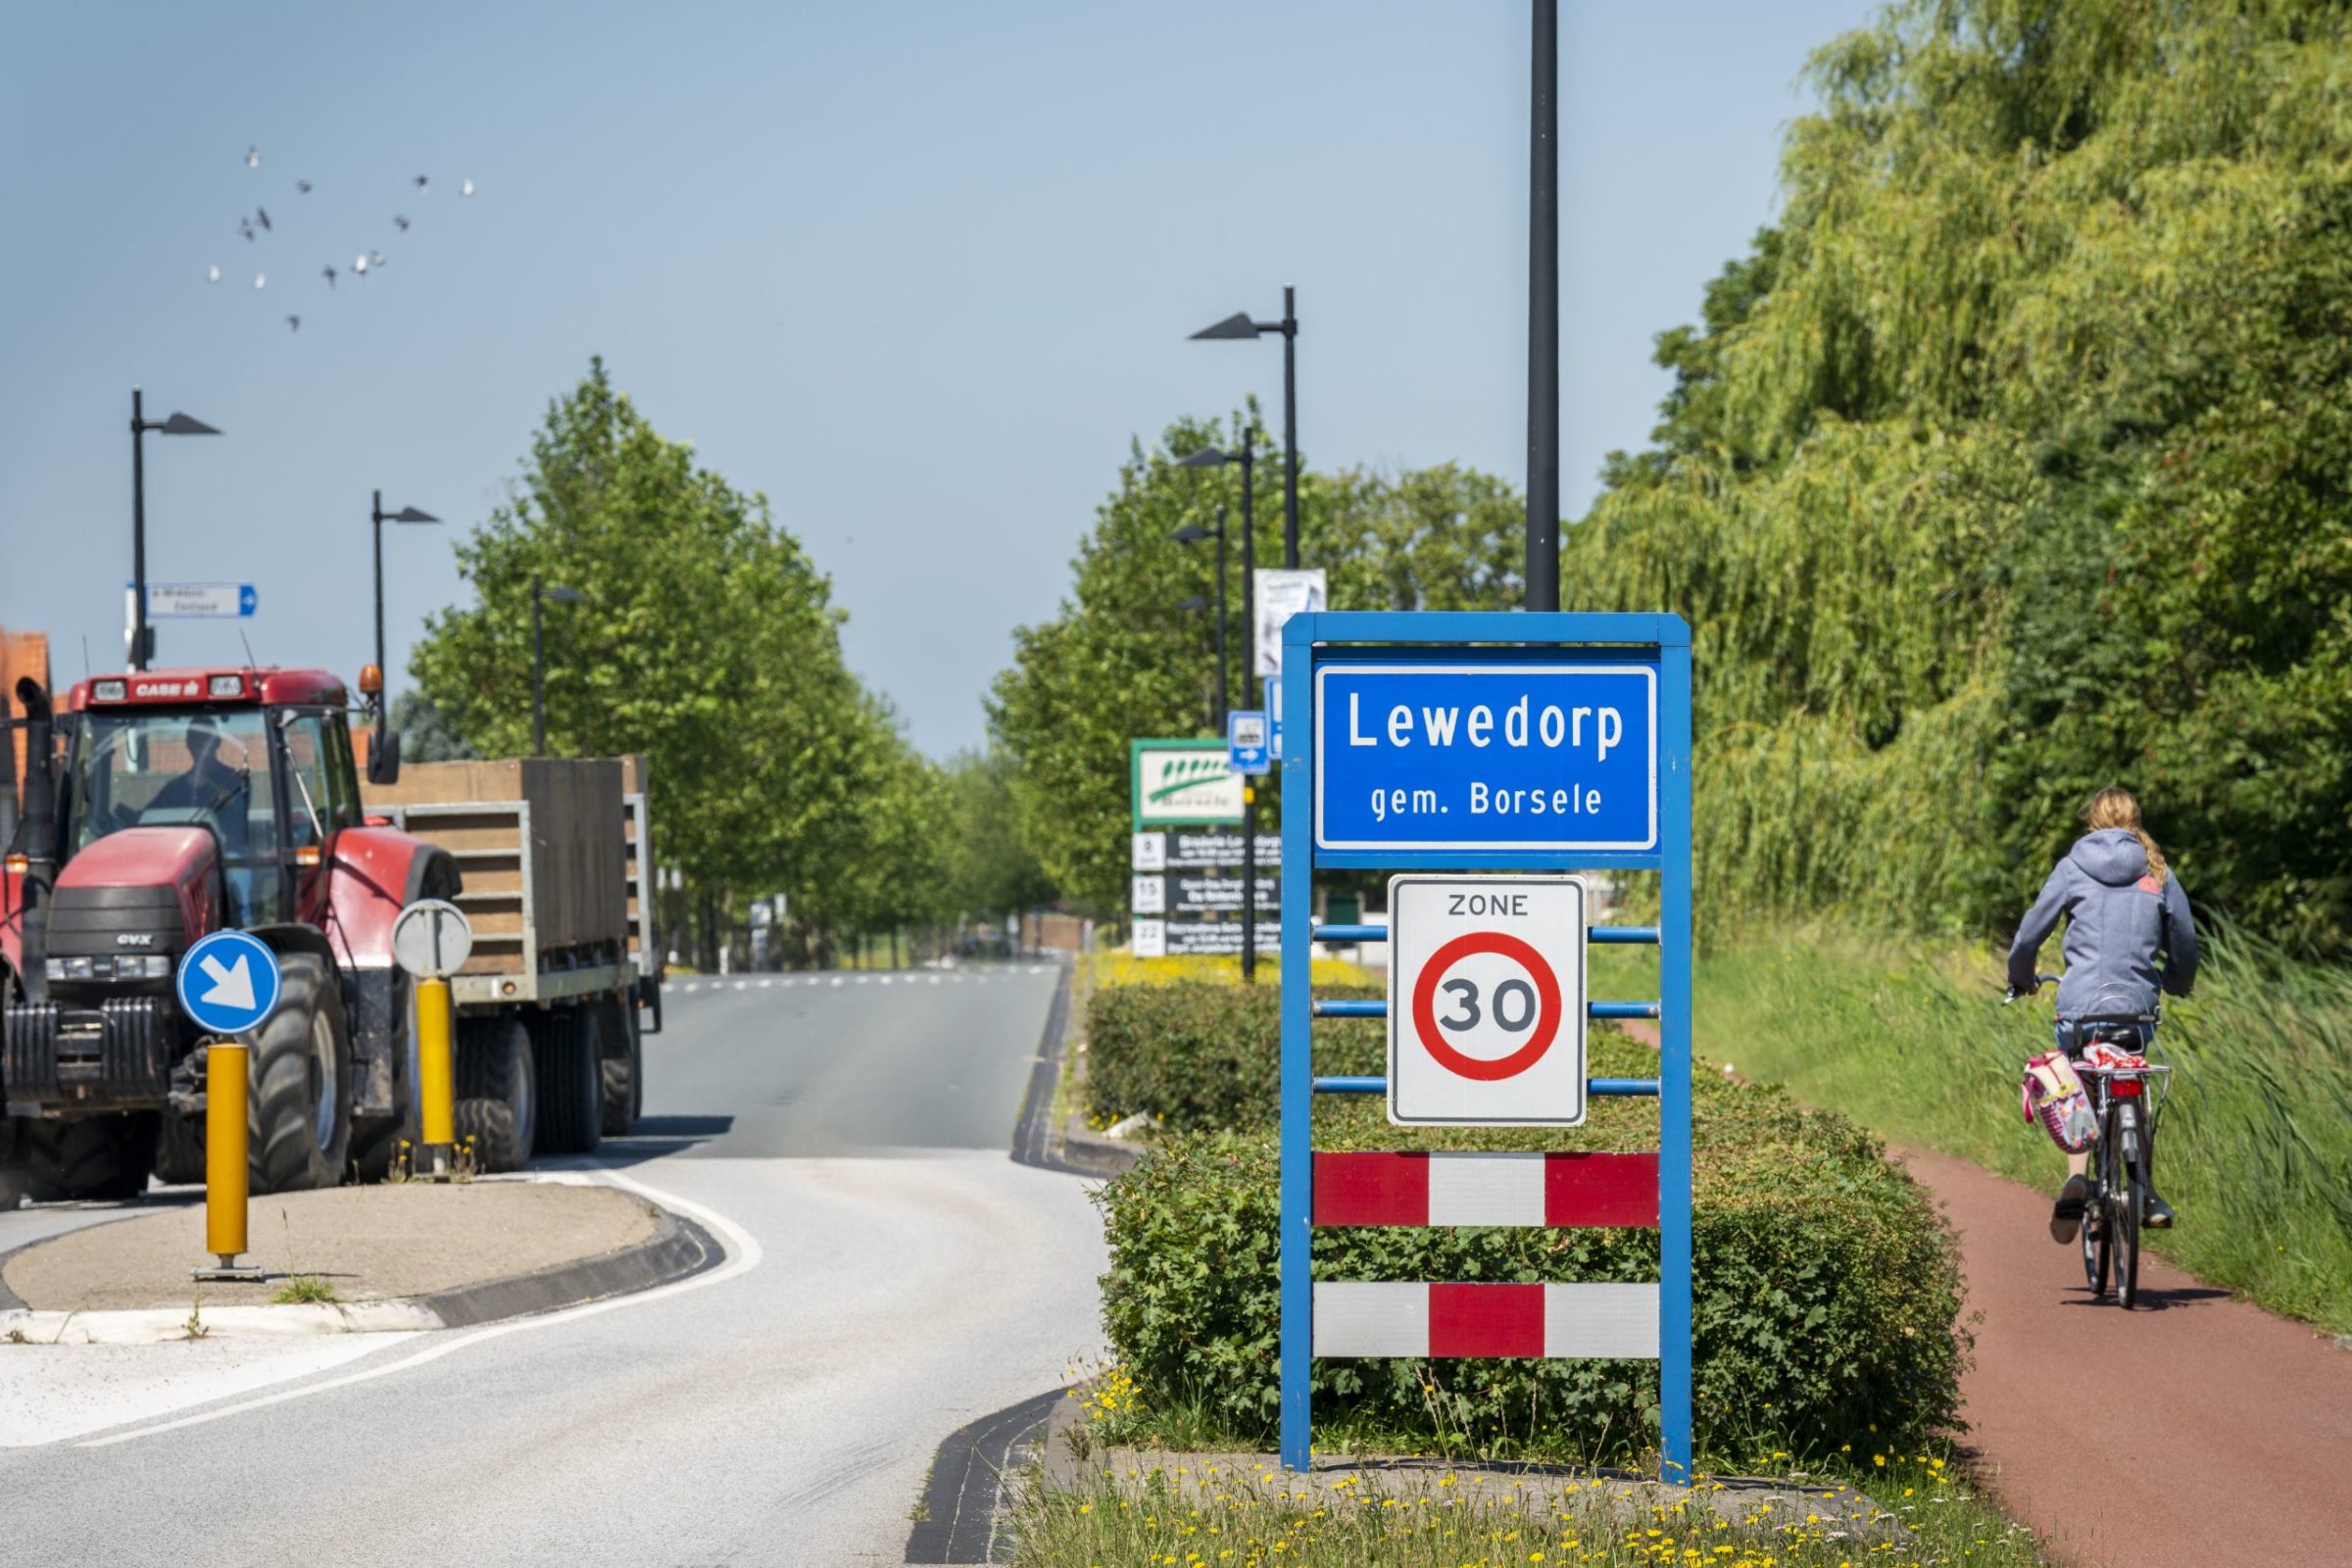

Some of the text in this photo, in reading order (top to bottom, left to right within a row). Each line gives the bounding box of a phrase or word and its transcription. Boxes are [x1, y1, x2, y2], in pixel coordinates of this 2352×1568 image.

[136, 683, 181, 697] CASE
[1349, 692, 1623, 762] Lewedorp
[1371, 782, 1601, 821] gem. Borsele
[1448, 894, 1529, 916] ZONE
[117, 934, 153, 946] CVX
[1439, 978, 1536, 1033] 30
